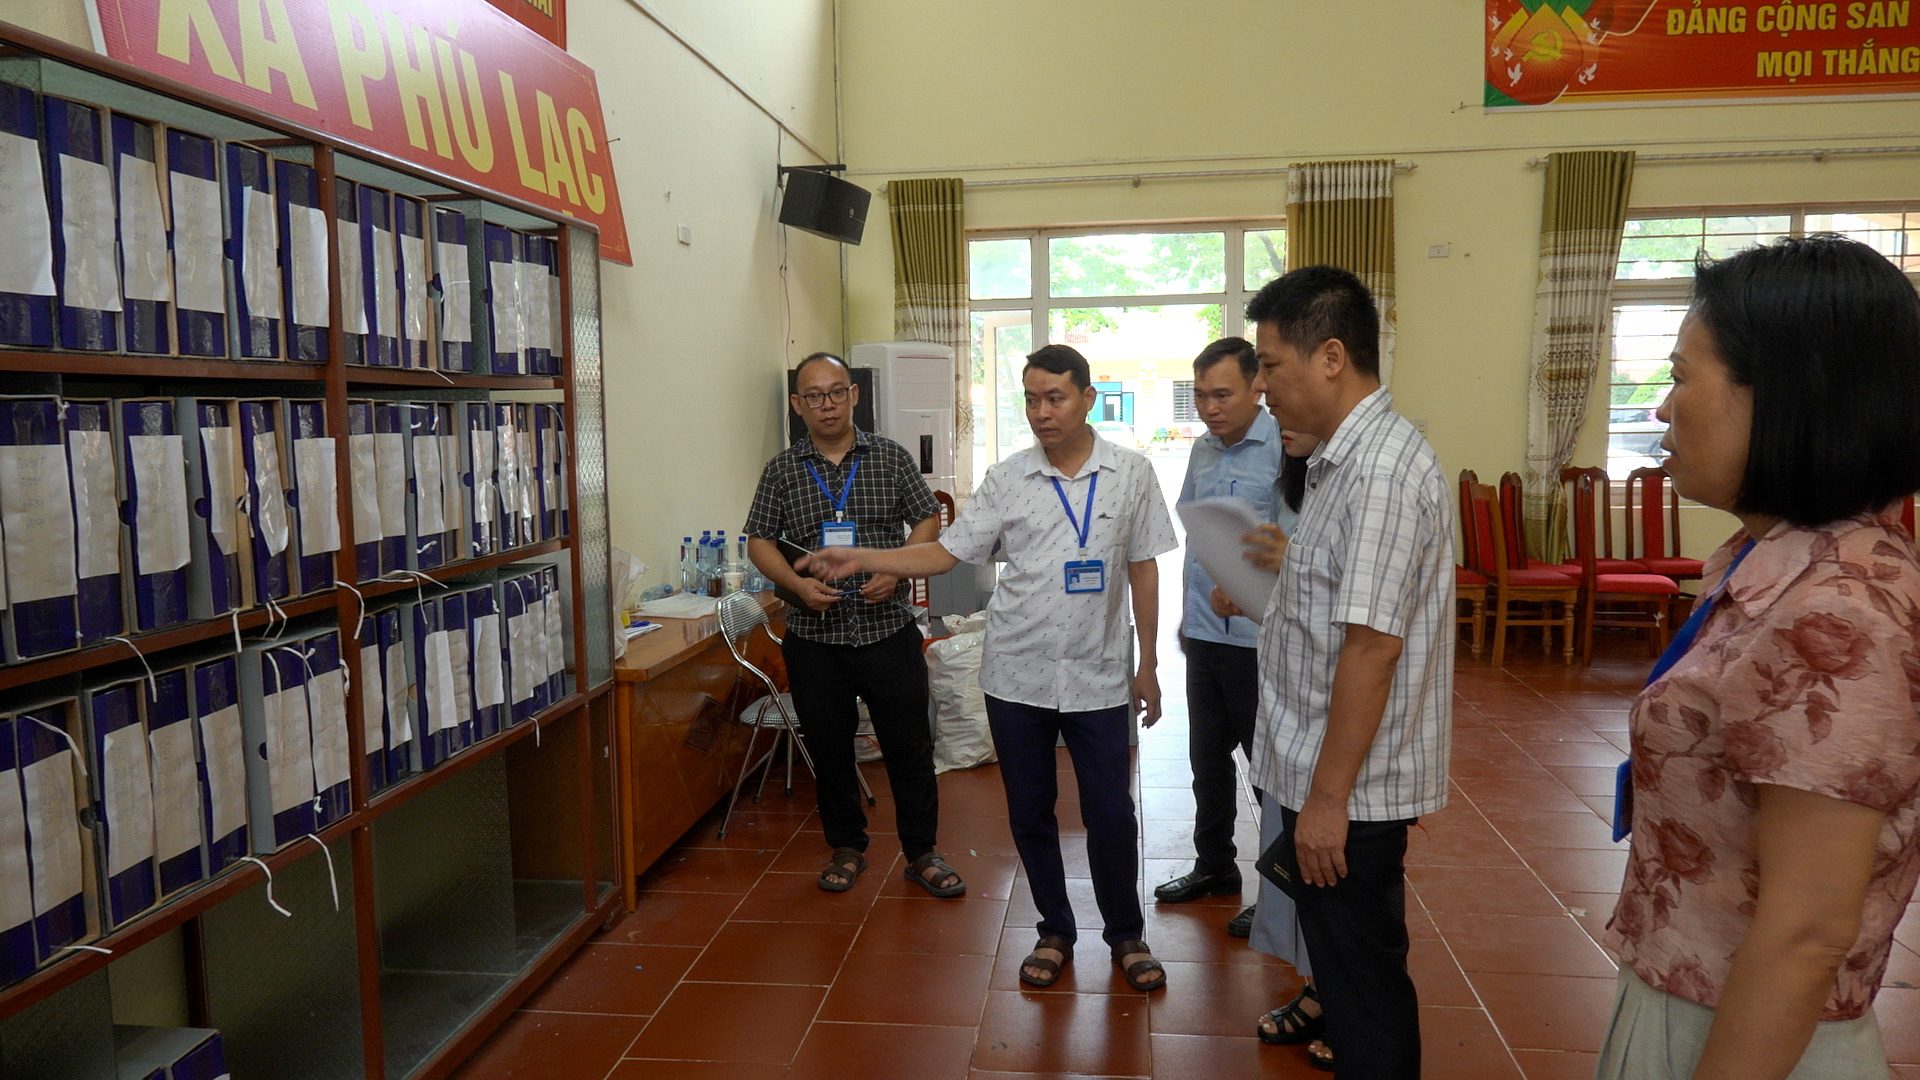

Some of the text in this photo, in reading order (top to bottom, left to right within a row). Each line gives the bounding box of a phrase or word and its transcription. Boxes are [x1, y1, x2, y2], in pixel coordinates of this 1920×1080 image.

[1666, 0, 1747, 35] ĐẢNG
[1757, 38, 1920, 83] MỌI THẮNG
[328, 0, 494, 173] PHÚ
